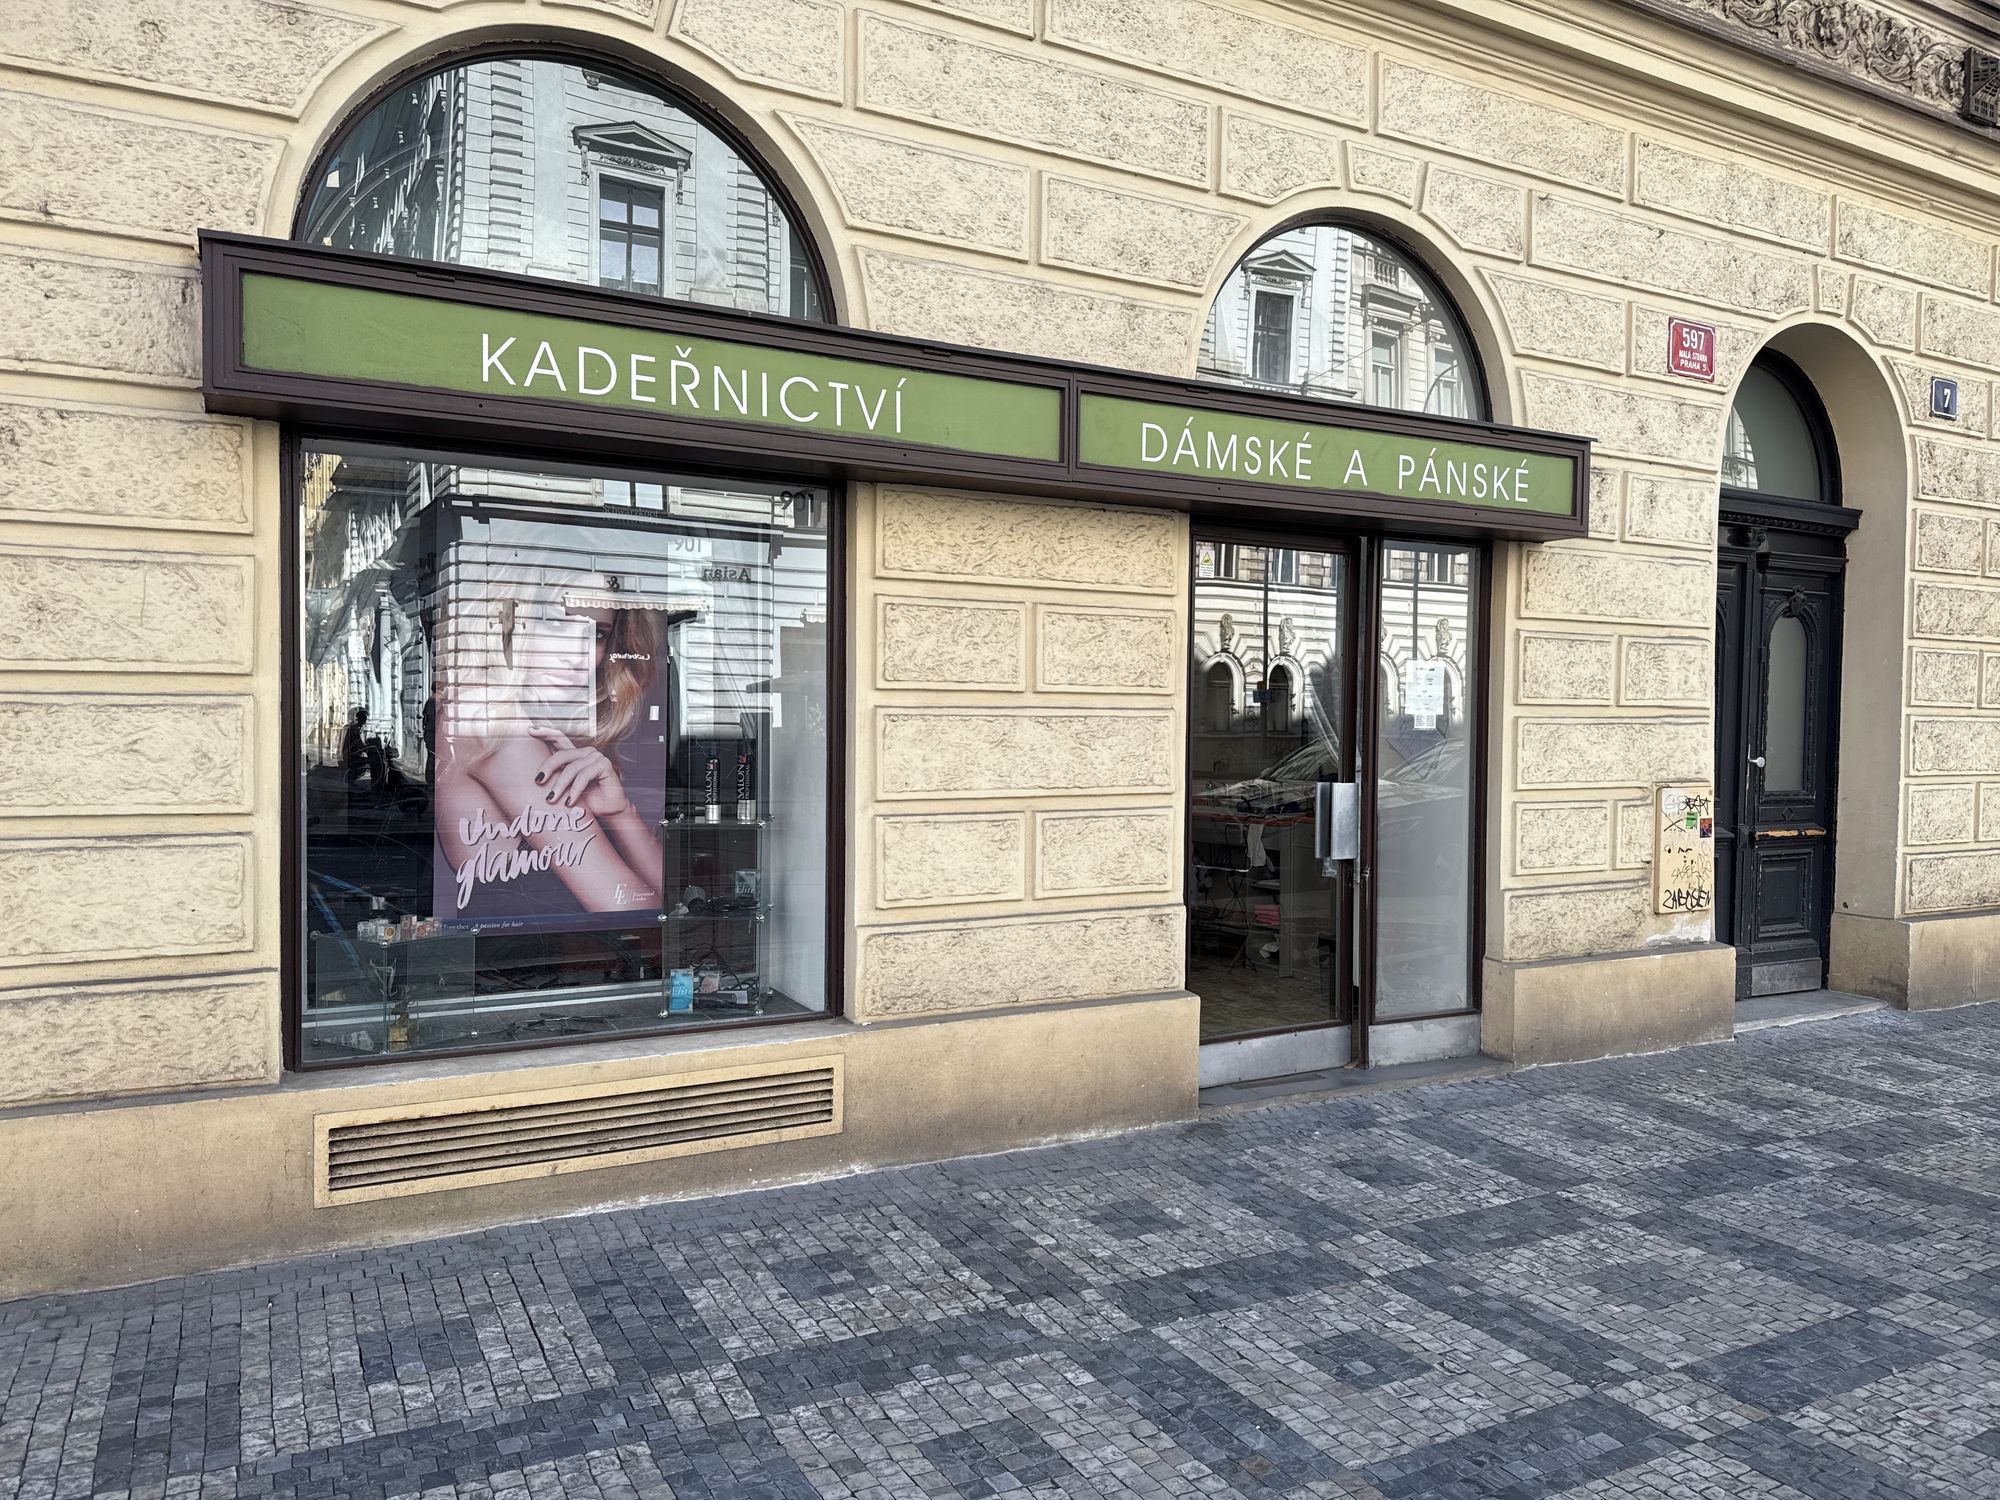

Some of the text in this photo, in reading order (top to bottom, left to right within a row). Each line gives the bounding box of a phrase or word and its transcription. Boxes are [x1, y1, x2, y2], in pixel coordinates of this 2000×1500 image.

[1682, 327, 1705, 350] 597
[1680, 359, 1707, 372] PRAHA 5
[482, 333, 907, 433] KADEŘNICTVÍ
[1943, 388, 1951, 408] 7
[1141, 416, 1530, 503] DÁMSKÉ A PÁNSKÉ
[737, 764, 745, 799] SALON
[456, 834, 597, 909] glamour
[501, 921, 510, 929] for
